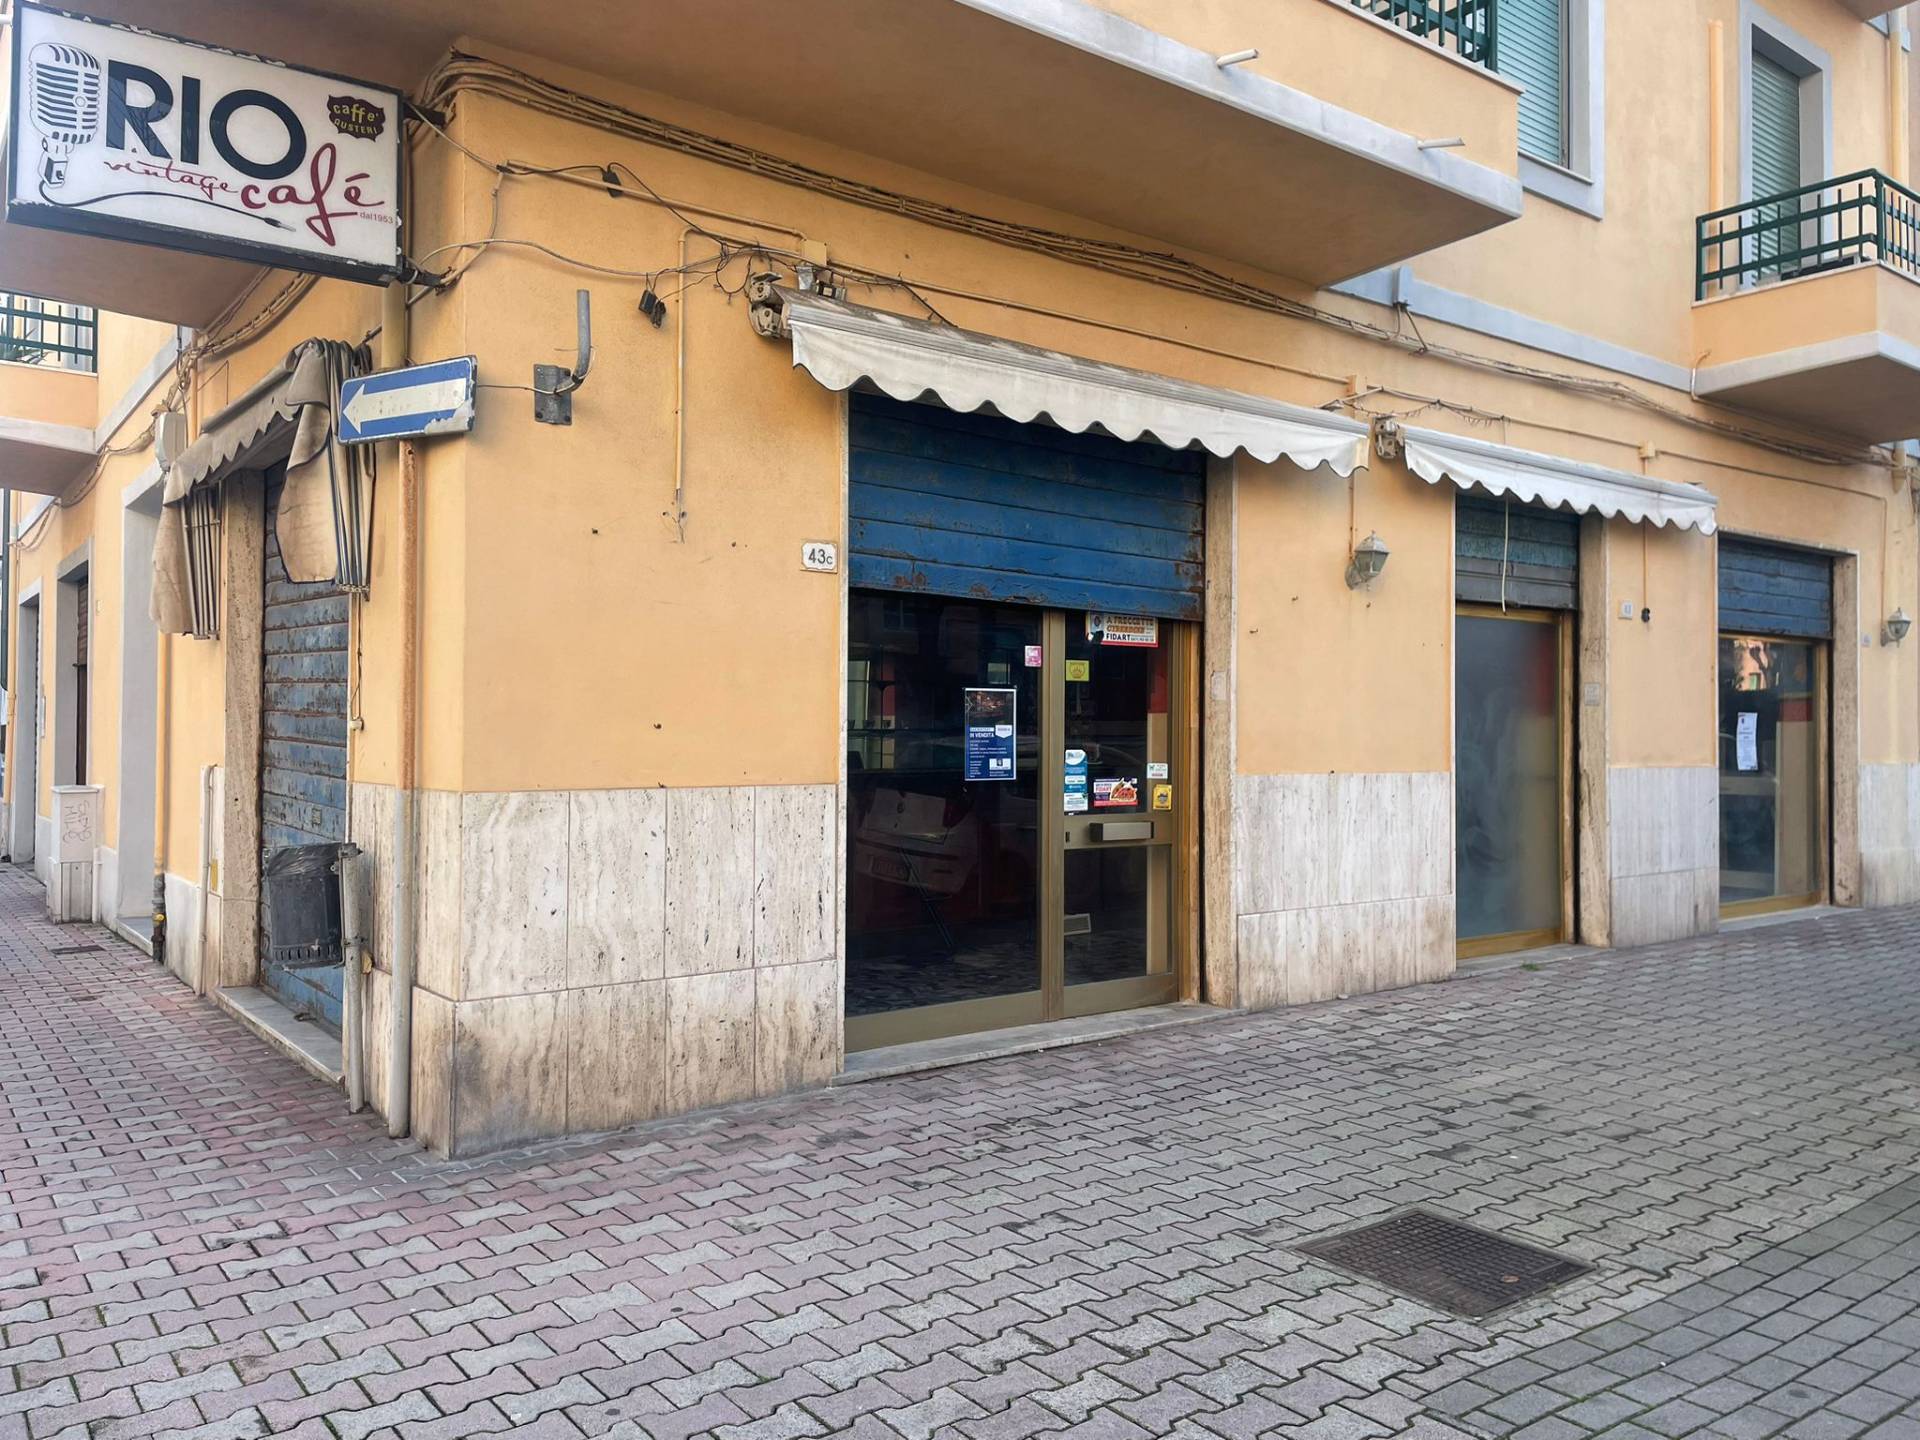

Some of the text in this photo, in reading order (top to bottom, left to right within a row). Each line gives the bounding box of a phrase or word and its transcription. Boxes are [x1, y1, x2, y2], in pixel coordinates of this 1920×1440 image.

[106, 60, 307, 180] RIO
[103, 142, 385, 247] vintage café
[1106, 633, 1131, 641] FIDART
